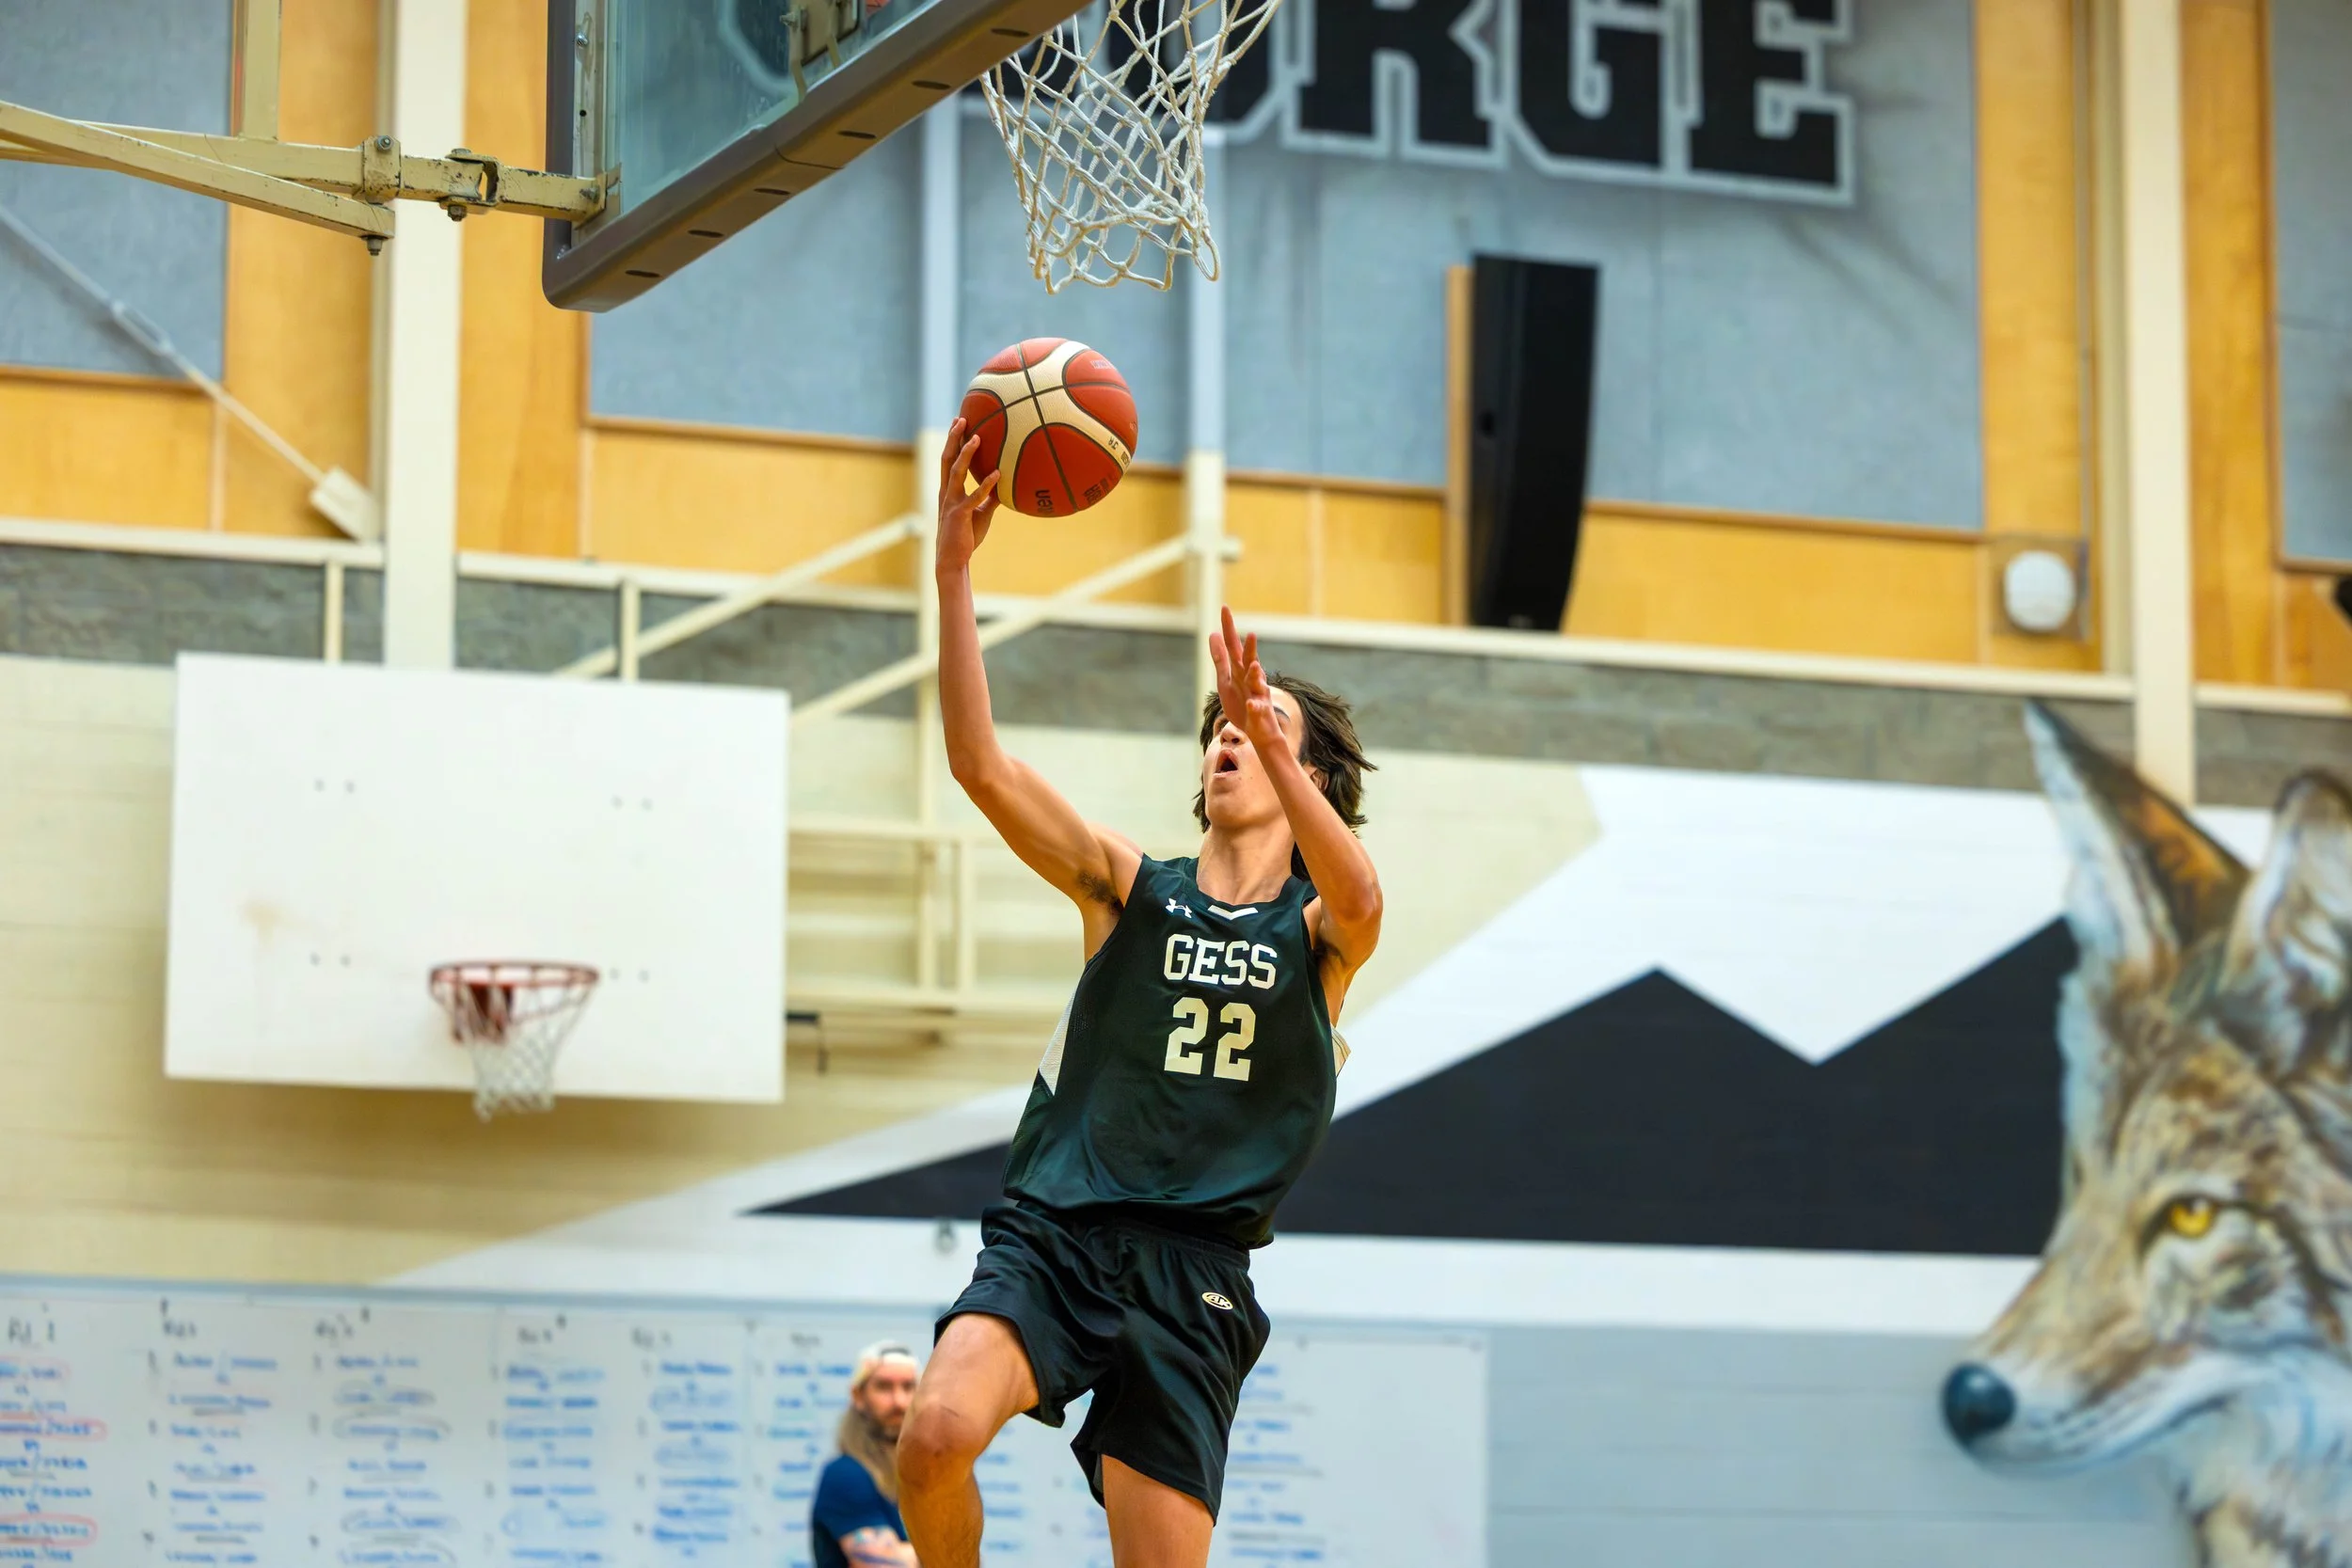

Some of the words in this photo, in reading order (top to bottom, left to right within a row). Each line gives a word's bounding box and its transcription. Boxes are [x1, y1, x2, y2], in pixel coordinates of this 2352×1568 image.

[963, 0, 1855, 203] ORGE
[1163, 933, 1278, 990] GESS
[1164, 996, 1257, 1082] 22
